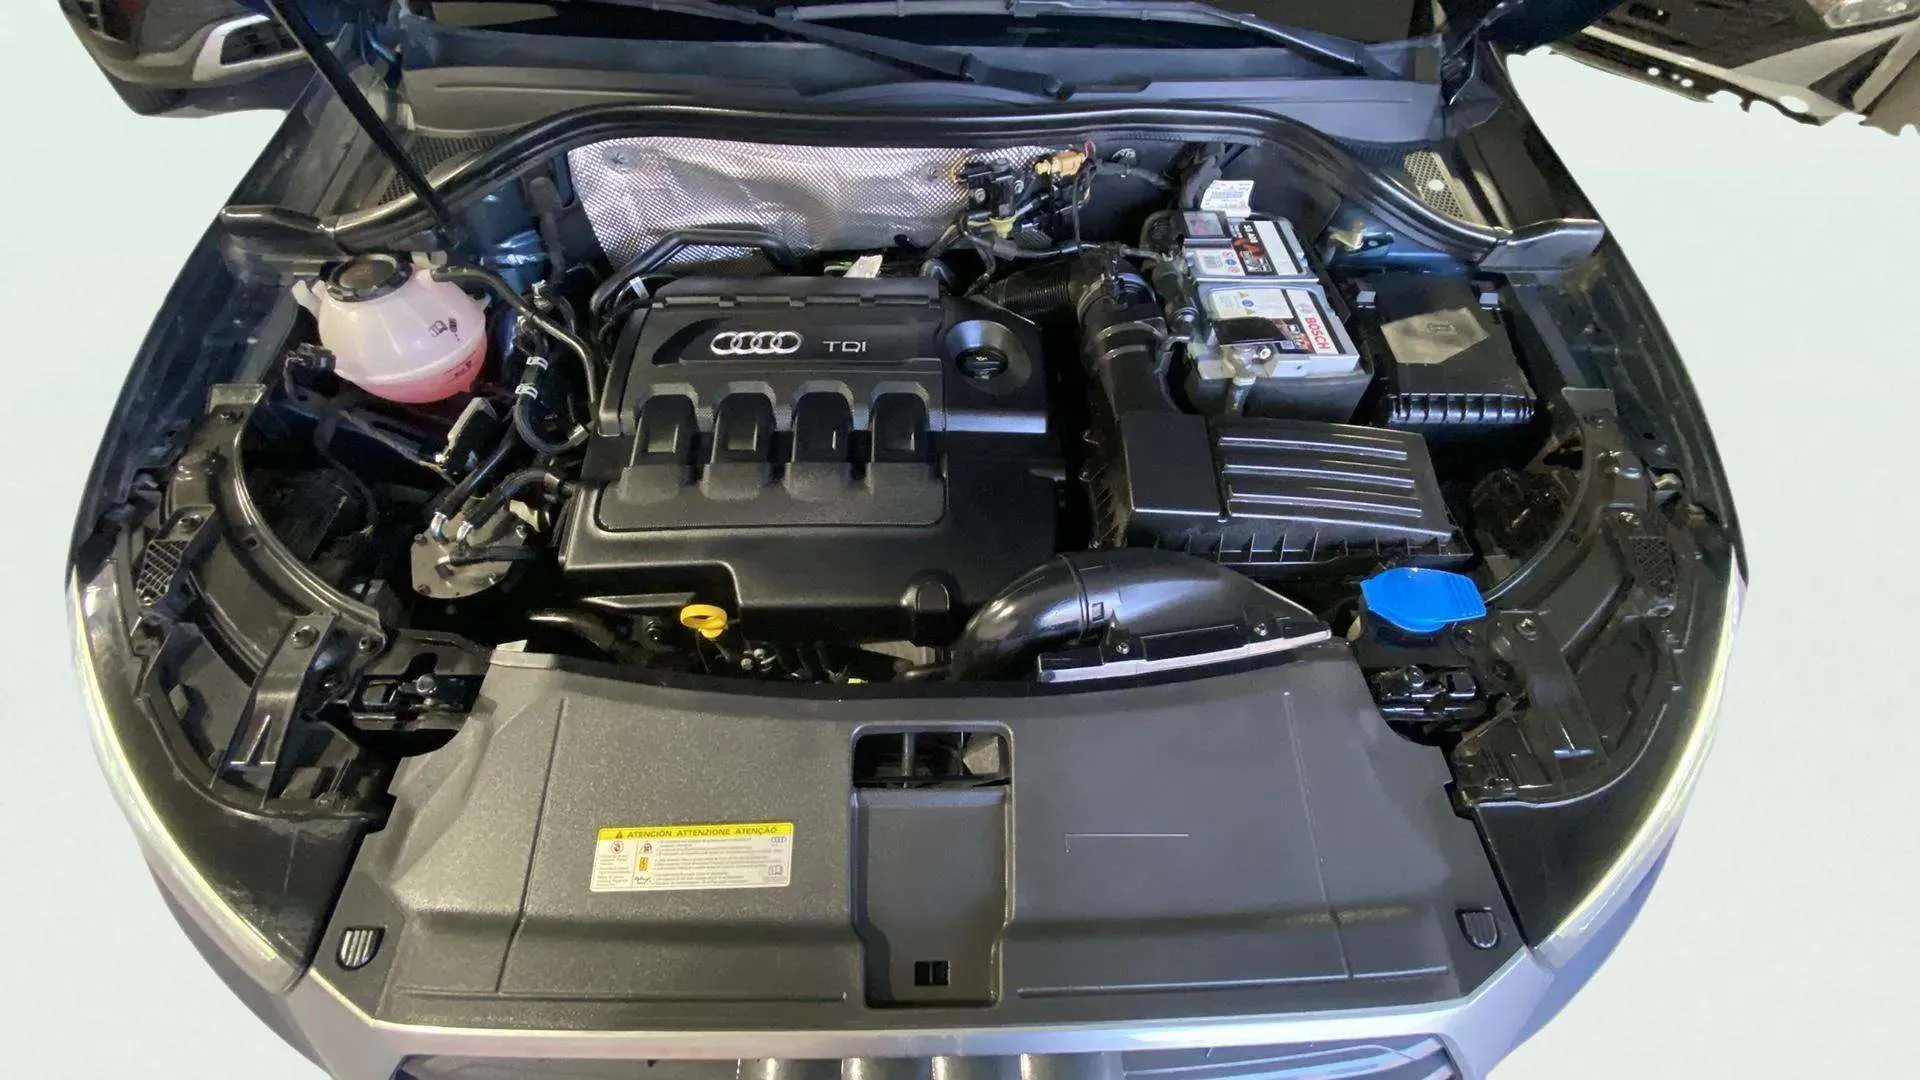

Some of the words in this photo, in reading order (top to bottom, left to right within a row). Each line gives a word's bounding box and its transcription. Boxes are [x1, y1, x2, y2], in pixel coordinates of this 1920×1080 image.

[1304, 317, 1331, 350] BOSCH
[823, 341, 867, 353] TDI
[627, 829, 673, 839] ATENCIÓN
[676, 828, 731, 837] ATTENZIONE
[735, 826, 777, 836] ATENÇÃO
